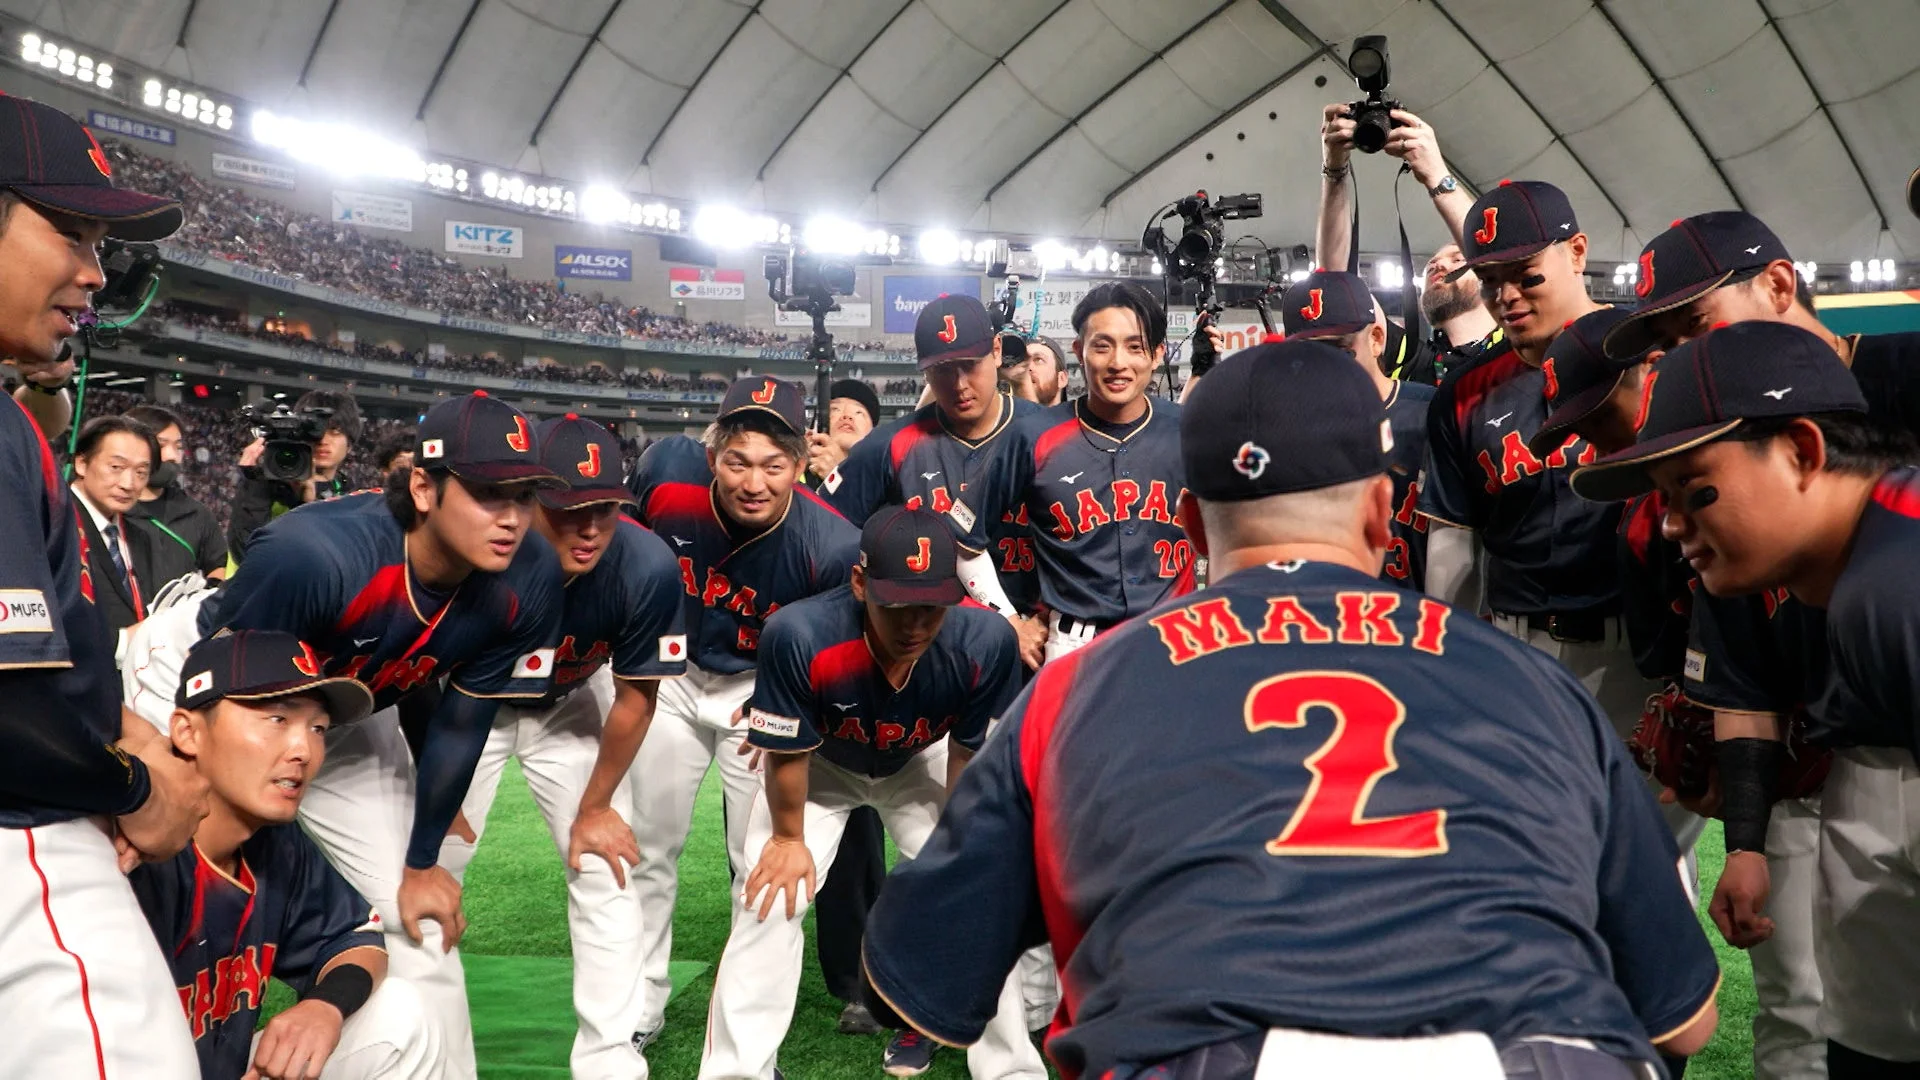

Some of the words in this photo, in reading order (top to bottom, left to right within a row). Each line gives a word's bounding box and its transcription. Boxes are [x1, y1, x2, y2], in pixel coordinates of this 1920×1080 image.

[454, 225, 513, 244] KITZ
[1474, 207, 1498, 245] J
[574, 254, 628, 268] ALSOK
[1635, 249, 1656, 298] J
[1300, 288, 1323, 321] J
[937, 314, 957, 344] J
[751, 380, 777, 405] J
[1542, 357, 1559, 401] J
[507, 415, 533, 453] J
[577, 443, 601, 478] J
[906, 536, 931, 573] J
[999, 537, 1035, 572] 25
[1153, 539, 1191, 578] 20
[10, 604, 46, 617] MUFG
[1149, 592, 1451, 666] MAKI
[292, 640, 320, 678] J
[1244, 670, 1449, 857] 2
